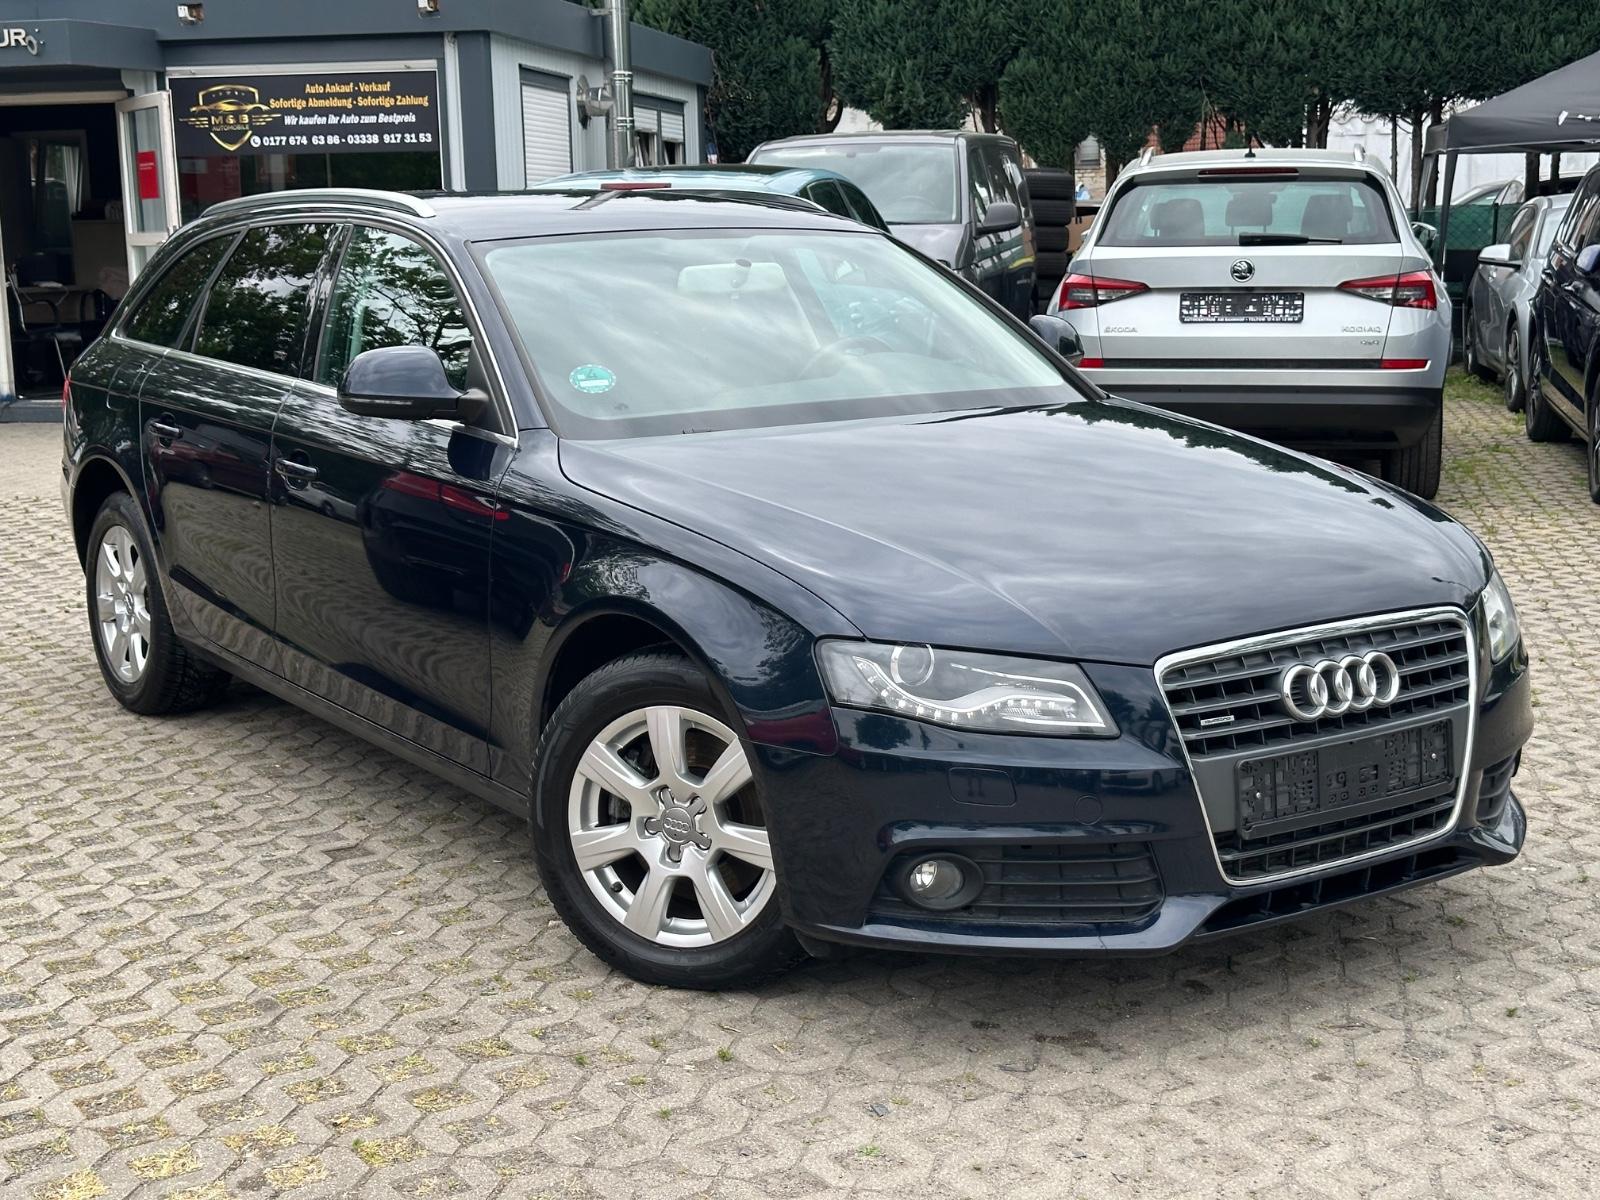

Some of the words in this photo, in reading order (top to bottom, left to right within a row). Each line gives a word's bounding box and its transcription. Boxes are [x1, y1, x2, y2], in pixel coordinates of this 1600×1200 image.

[305, 83, 325, 94] Auto
[325, 82, 354, 93] Ankauf
[359, 81, 391, 92] Verkauf
[269, 97, 307, 110] Sofortige
[308, 96, 353, 109] Abmeldung
[357, 95, 395, 108] Sofortige
[396, 95, 429, 107] Zahlung
[211, 115, 223, 125] M
[284, 114, 298, 126] Wir
[298, 113, 327, 125] kaufen
[327, 113, 340, 125] ihr
[339, 113, 360, 124] Auto
[360, 115, 378, 124] zum
[378, 112, 416, 125] Bestpreis
[262, 135, 287, 146] 0177
[289, 135, 308, 146] 674
[311, 134, 325, 145] 63
[326, 134, 341, 145] 86
[347, 133, 380, 144] 03338
[383, 133, 402, 144] 917
[404, 133, 418, 144] 31
[418, 132, 432, 143] 53
